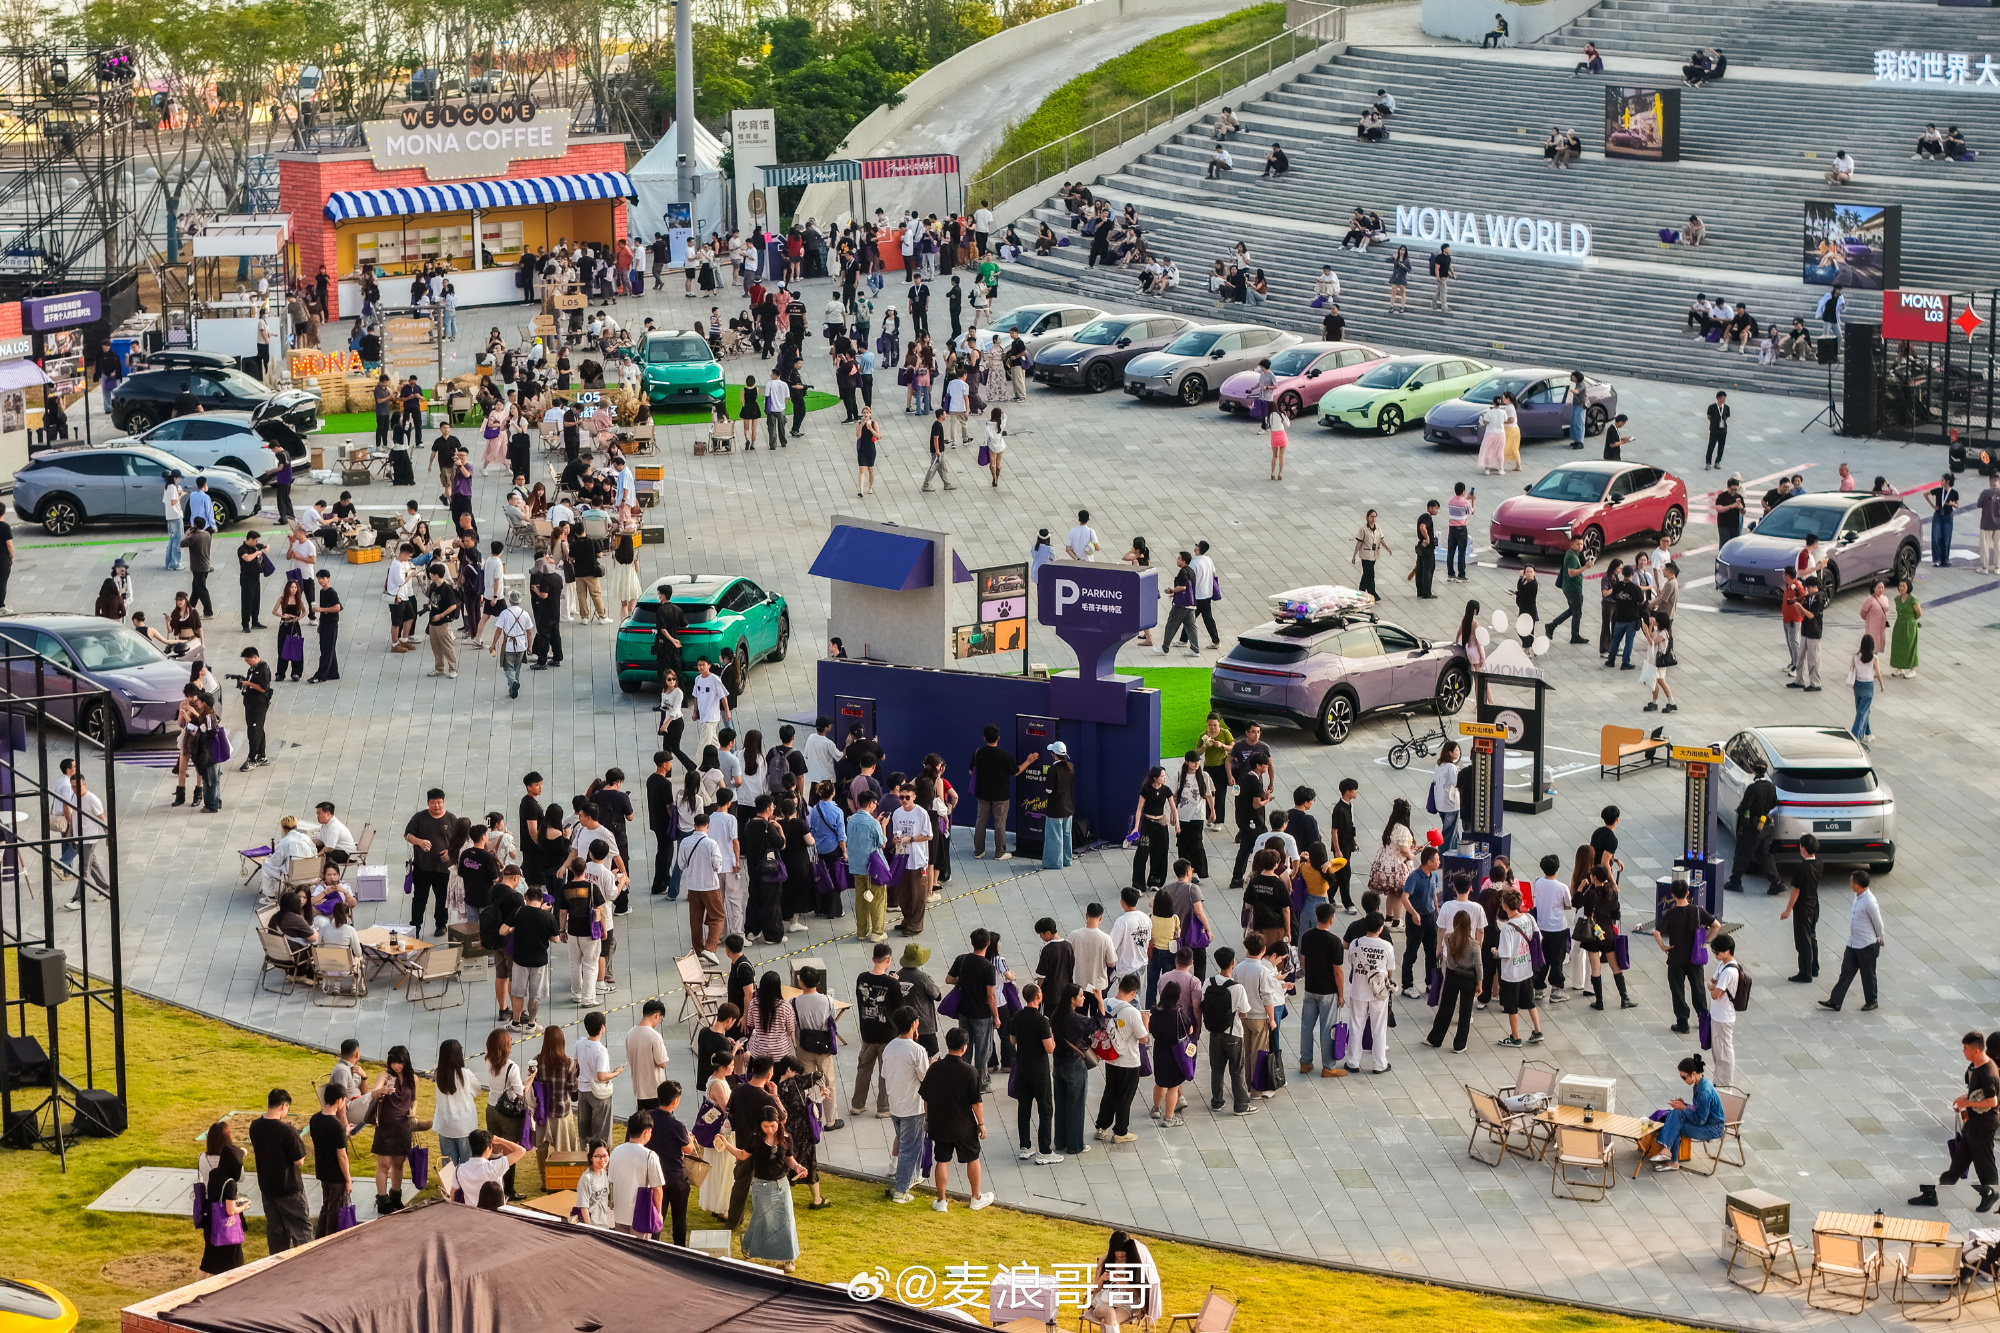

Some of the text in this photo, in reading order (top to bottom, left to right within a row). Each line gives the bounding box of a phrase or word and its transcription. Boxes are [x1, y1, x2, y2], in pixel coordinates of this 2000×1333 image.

[1874, 49, 2000, 87] 我的世界 大
[402, 105, 531, 126] WELCOME
[737, 119, 770, 131] 体育馆
[386, 126, 553, 156] MONA COFFEE
[1396, 205, 1591, 258] MONA WORLD
[1901, 293, 1943, 310] MONA
[1924, 309, 1944, 322] L03
[14, 340, 30, 354] L05
[291, 350, 364, 378] MONA
[576, 391, 600, 404] L05
[1055, 579, 1123, 615] P PARKING
[1081, 603, 1123, 614] 毛孩子等待区
[1465, 726, 1494, 734] 大力出续航
[1679, 750, 1710, 759] 大力出续航
